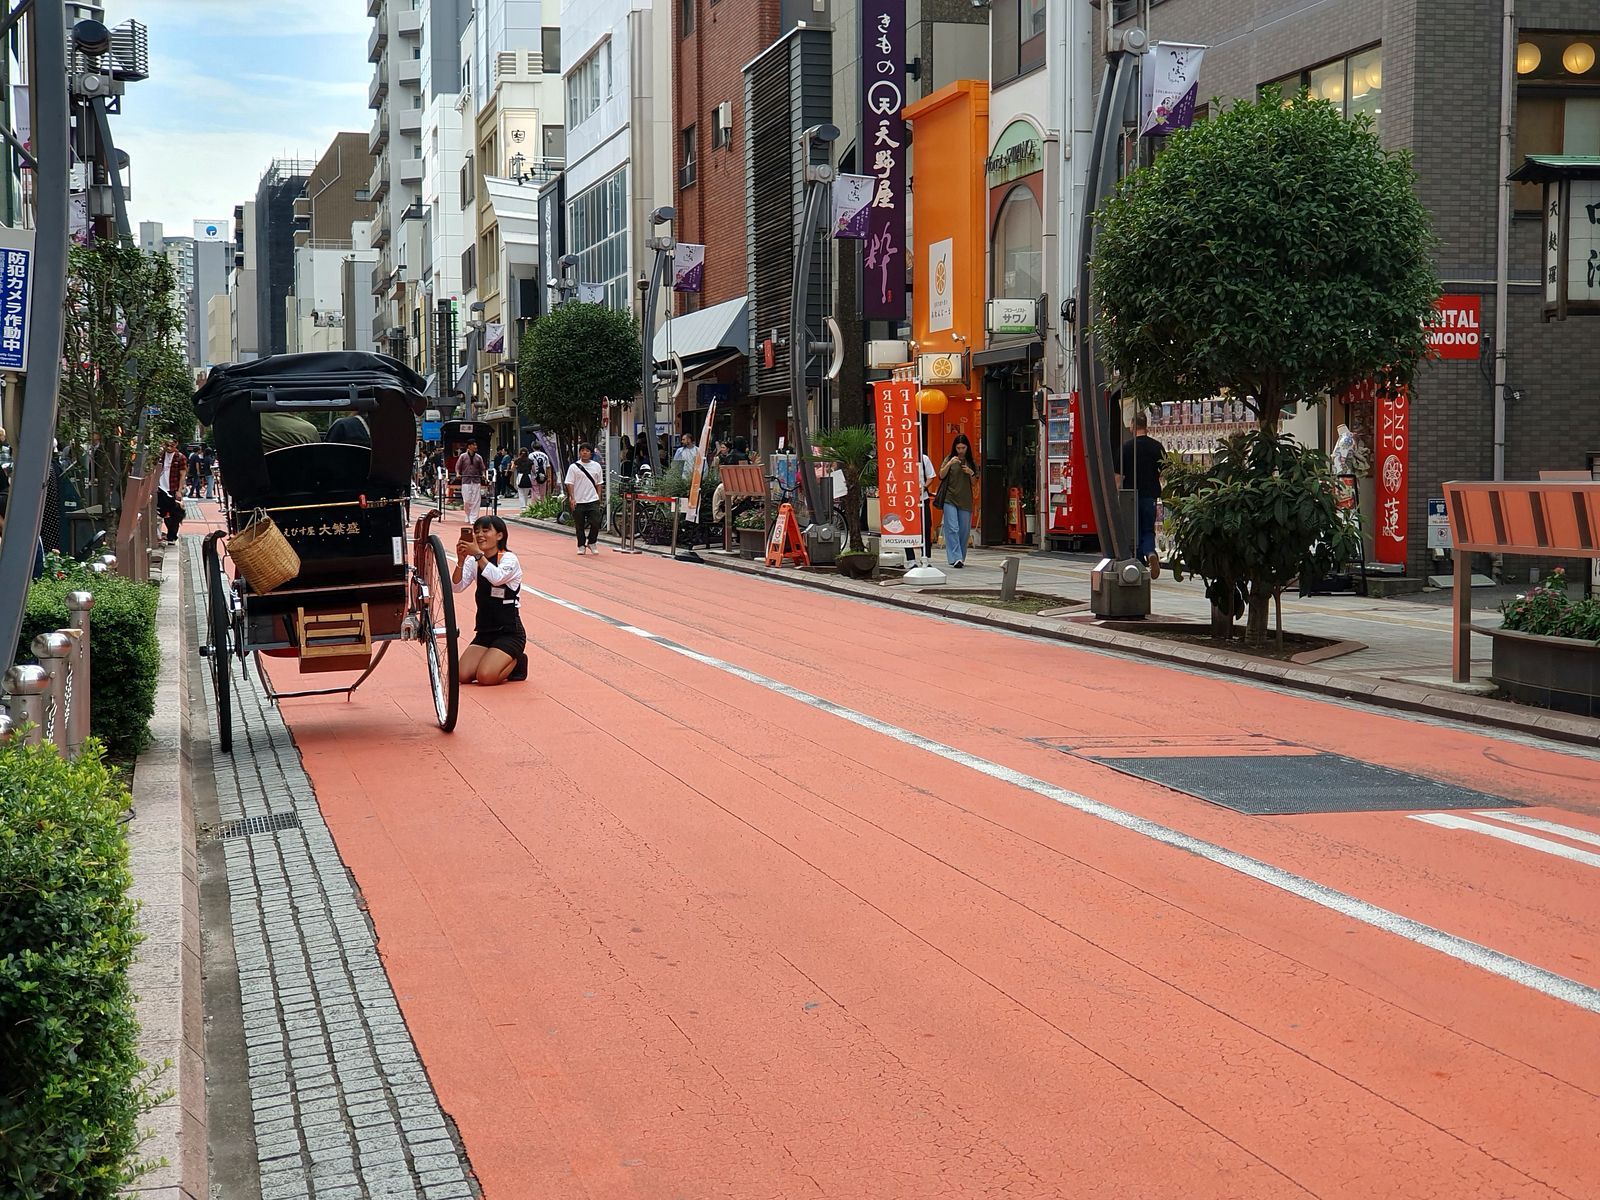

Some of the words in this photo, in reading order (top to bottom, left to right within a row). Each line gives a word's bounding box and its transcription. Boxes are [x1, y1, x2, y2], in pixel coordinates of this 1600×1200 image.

[875, 13, 895, 76] きもの
[872, 119, 900, 209] 天野屋
[3, 251, 26, 352] 防犯カメラ作動中
[1002, 313, 1027, 324] サワノ
[319, 521, 361, 536] 大繁盛
